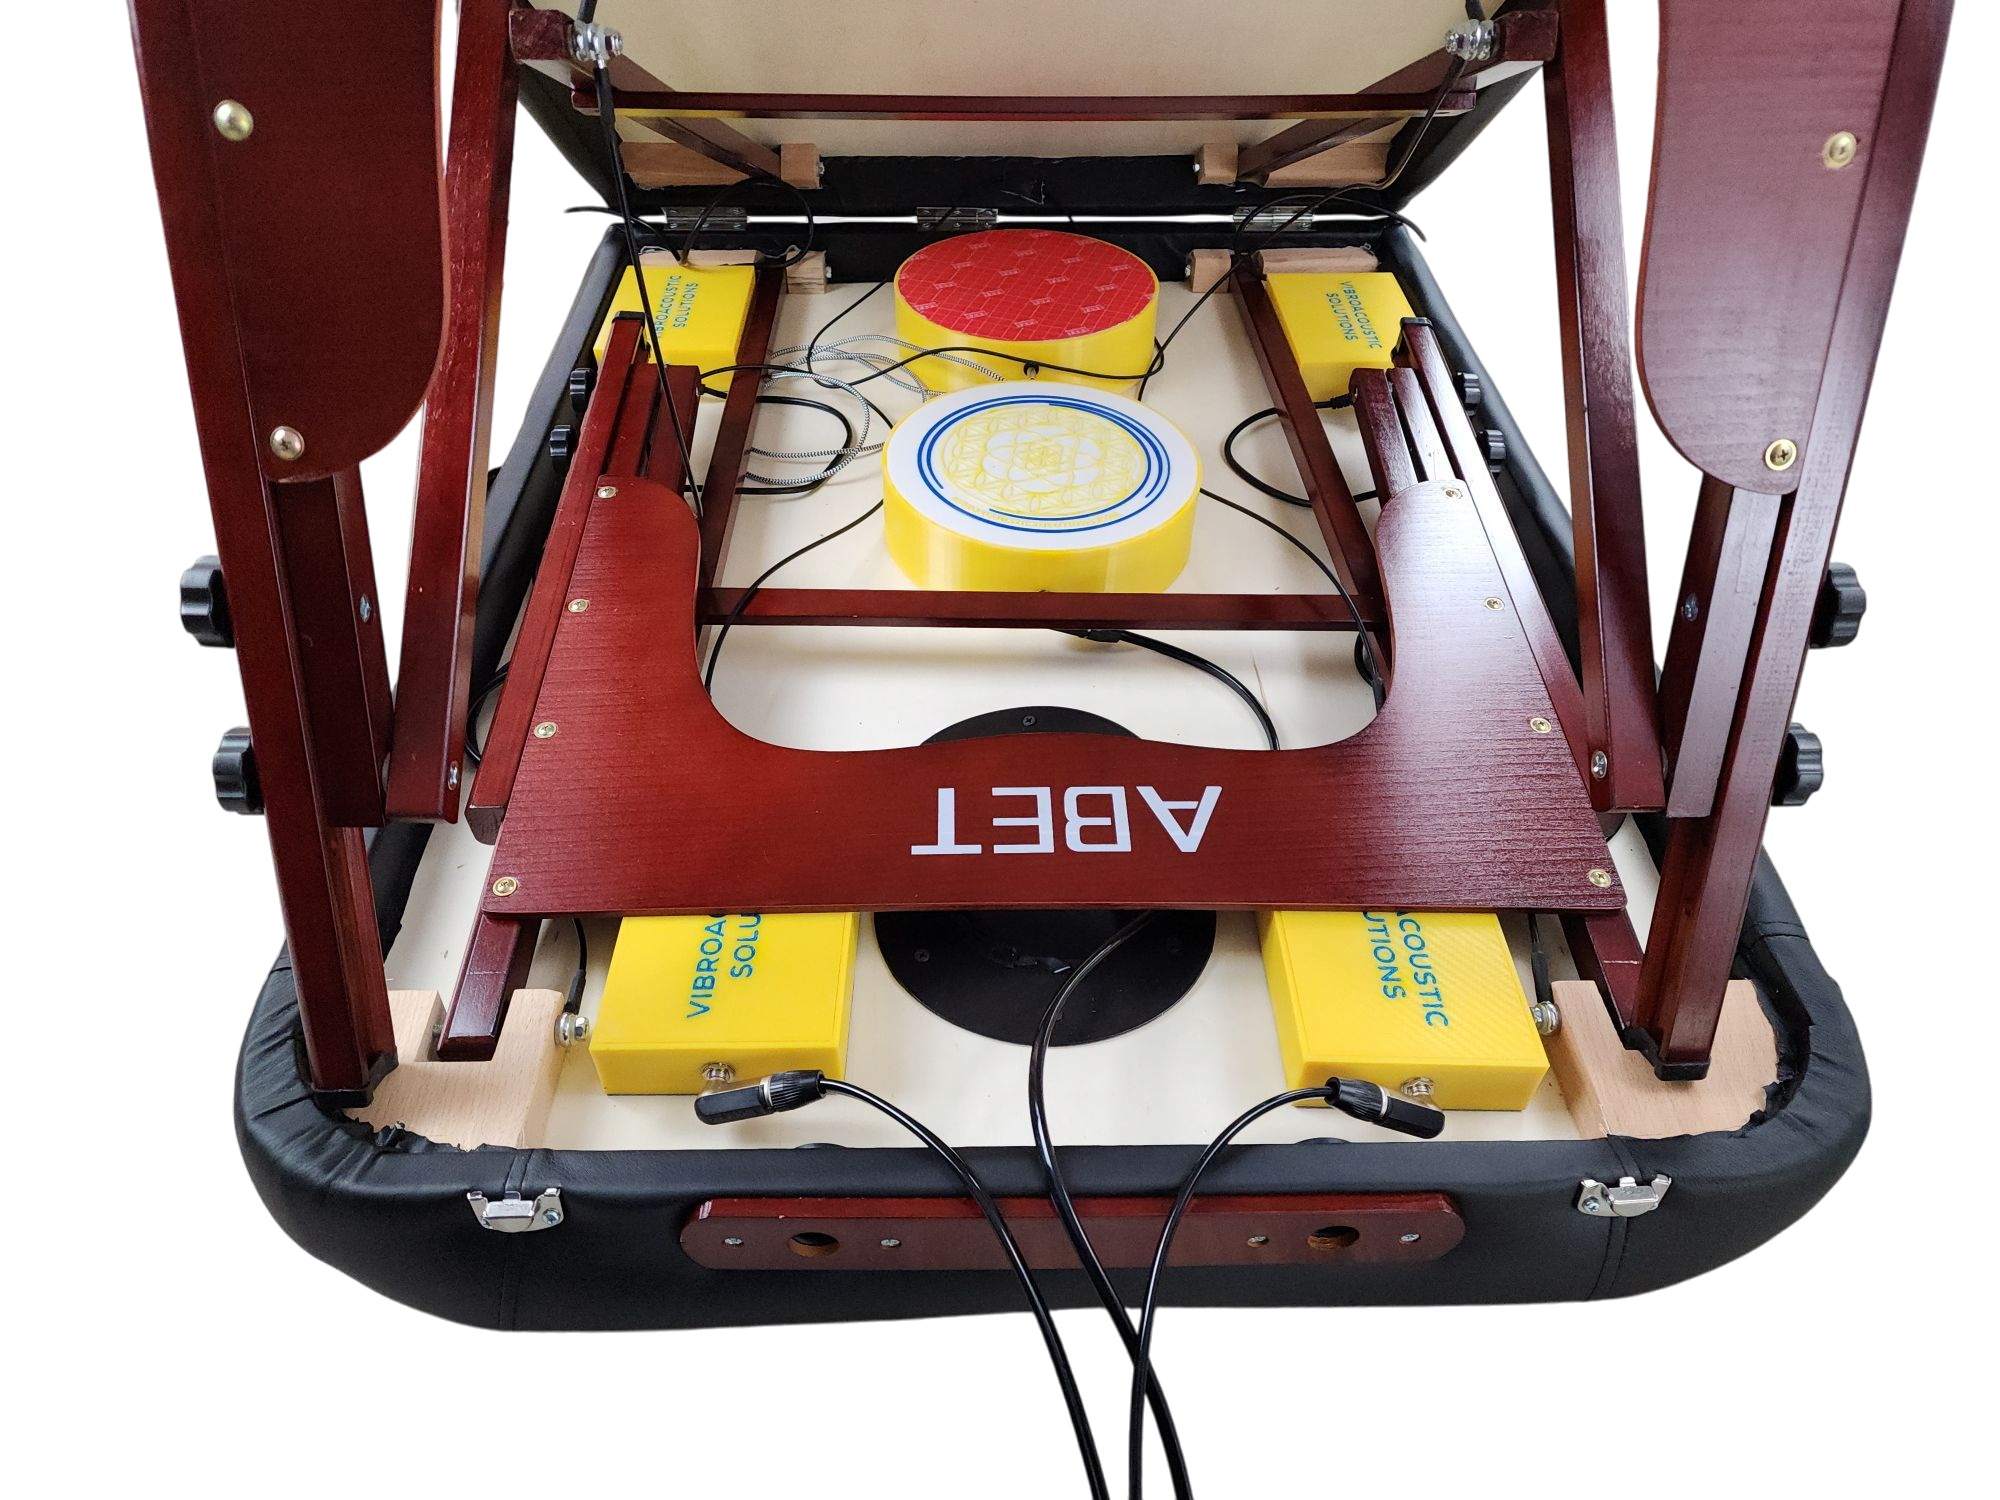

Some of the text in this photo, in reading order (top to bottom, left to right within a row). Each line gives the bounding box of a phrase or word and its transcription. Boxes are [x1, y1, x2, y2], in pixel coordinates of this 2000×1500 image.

[672, 283, 699, 328] SOLUTIONS
[1326, 292, 1358, 341] SOLUTIONS
[1339, 280, 1382, 349] VIBROACOUSTIC
[911, 785, 1222, 855] ABET
[686, 913, 727, 1018] VIBROA
[729, 913, 761, 977] SOLU
[1396, 911, 1448, 1027] COUSTIC
